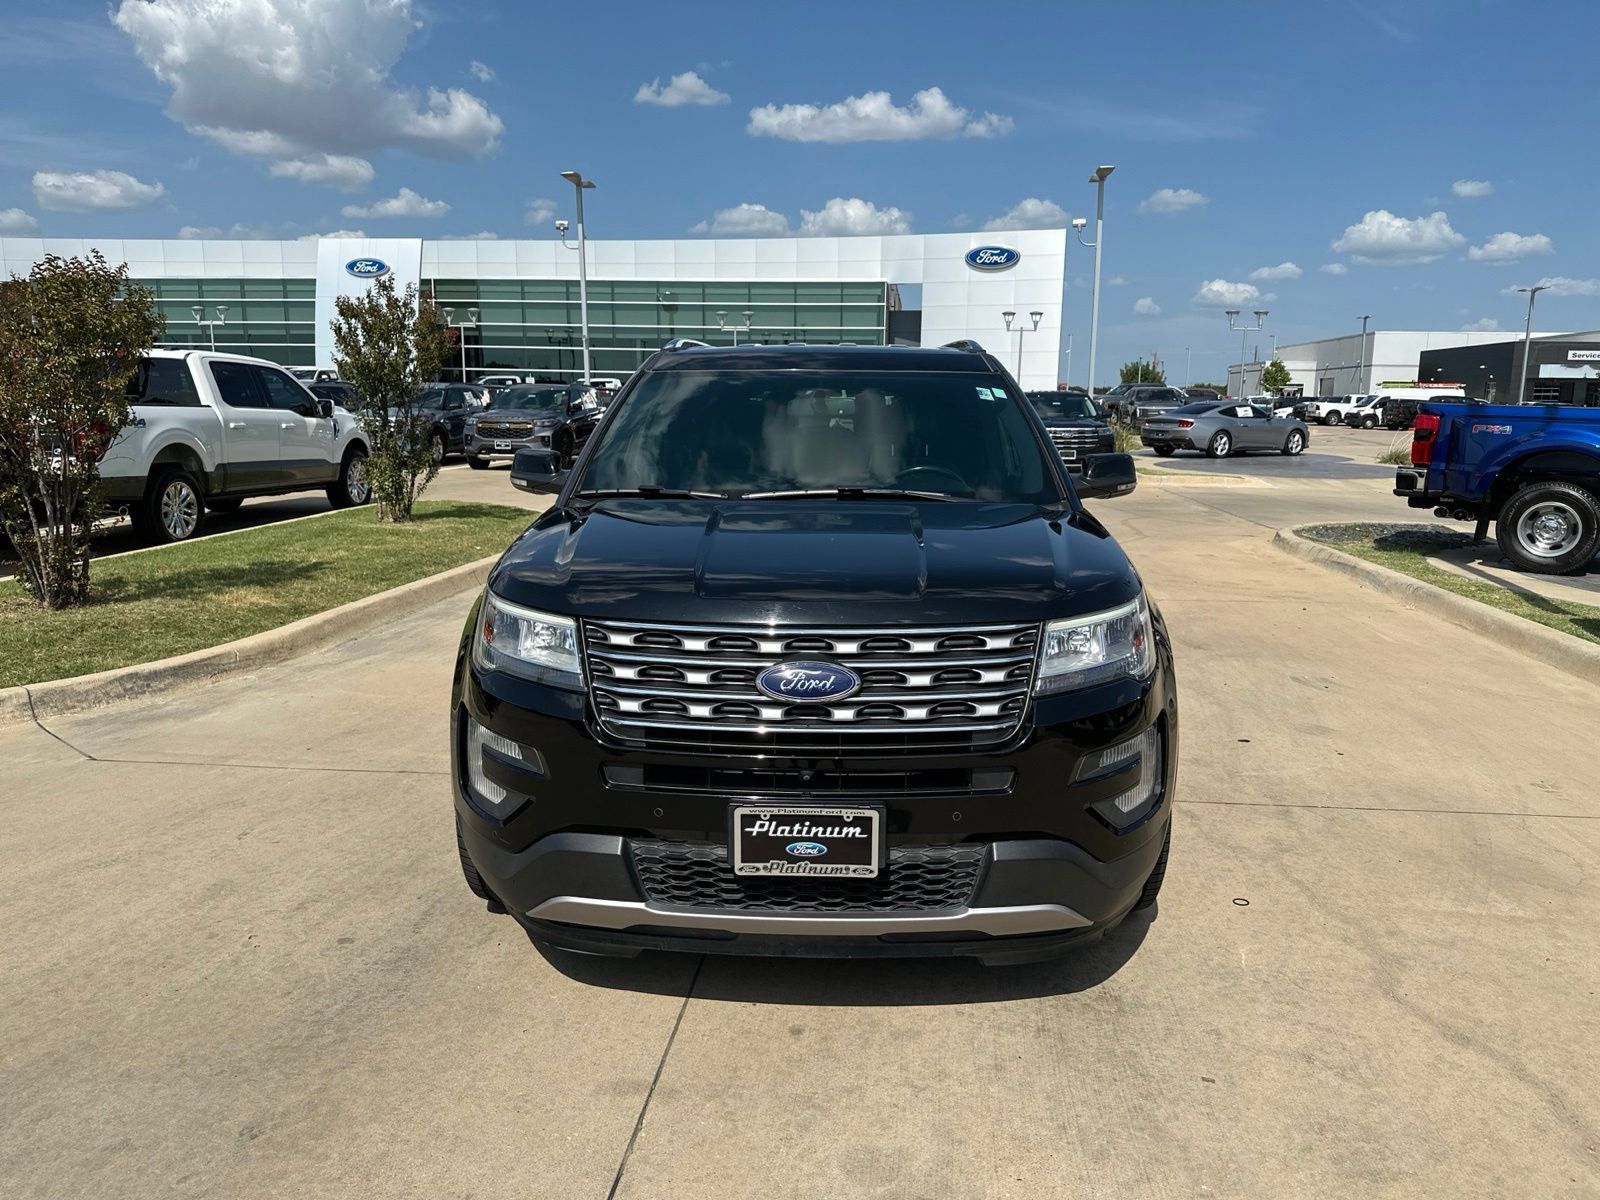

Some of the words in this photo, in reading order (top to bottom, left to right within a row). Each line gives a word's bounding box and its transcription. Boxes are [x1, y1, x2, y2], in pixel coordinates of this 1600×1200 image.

[976, 249, 1008, 264] Ford
[353, 261, 379, 272] Ford
[780, 669, 837, 692] Ford
[748, 808, 866, 816] www.PlatinumFord.com
[744, 820, 868, 838] Platinum
[793, 844, 819, 855] Ford
[768, 861, 843, 876] Platinum
